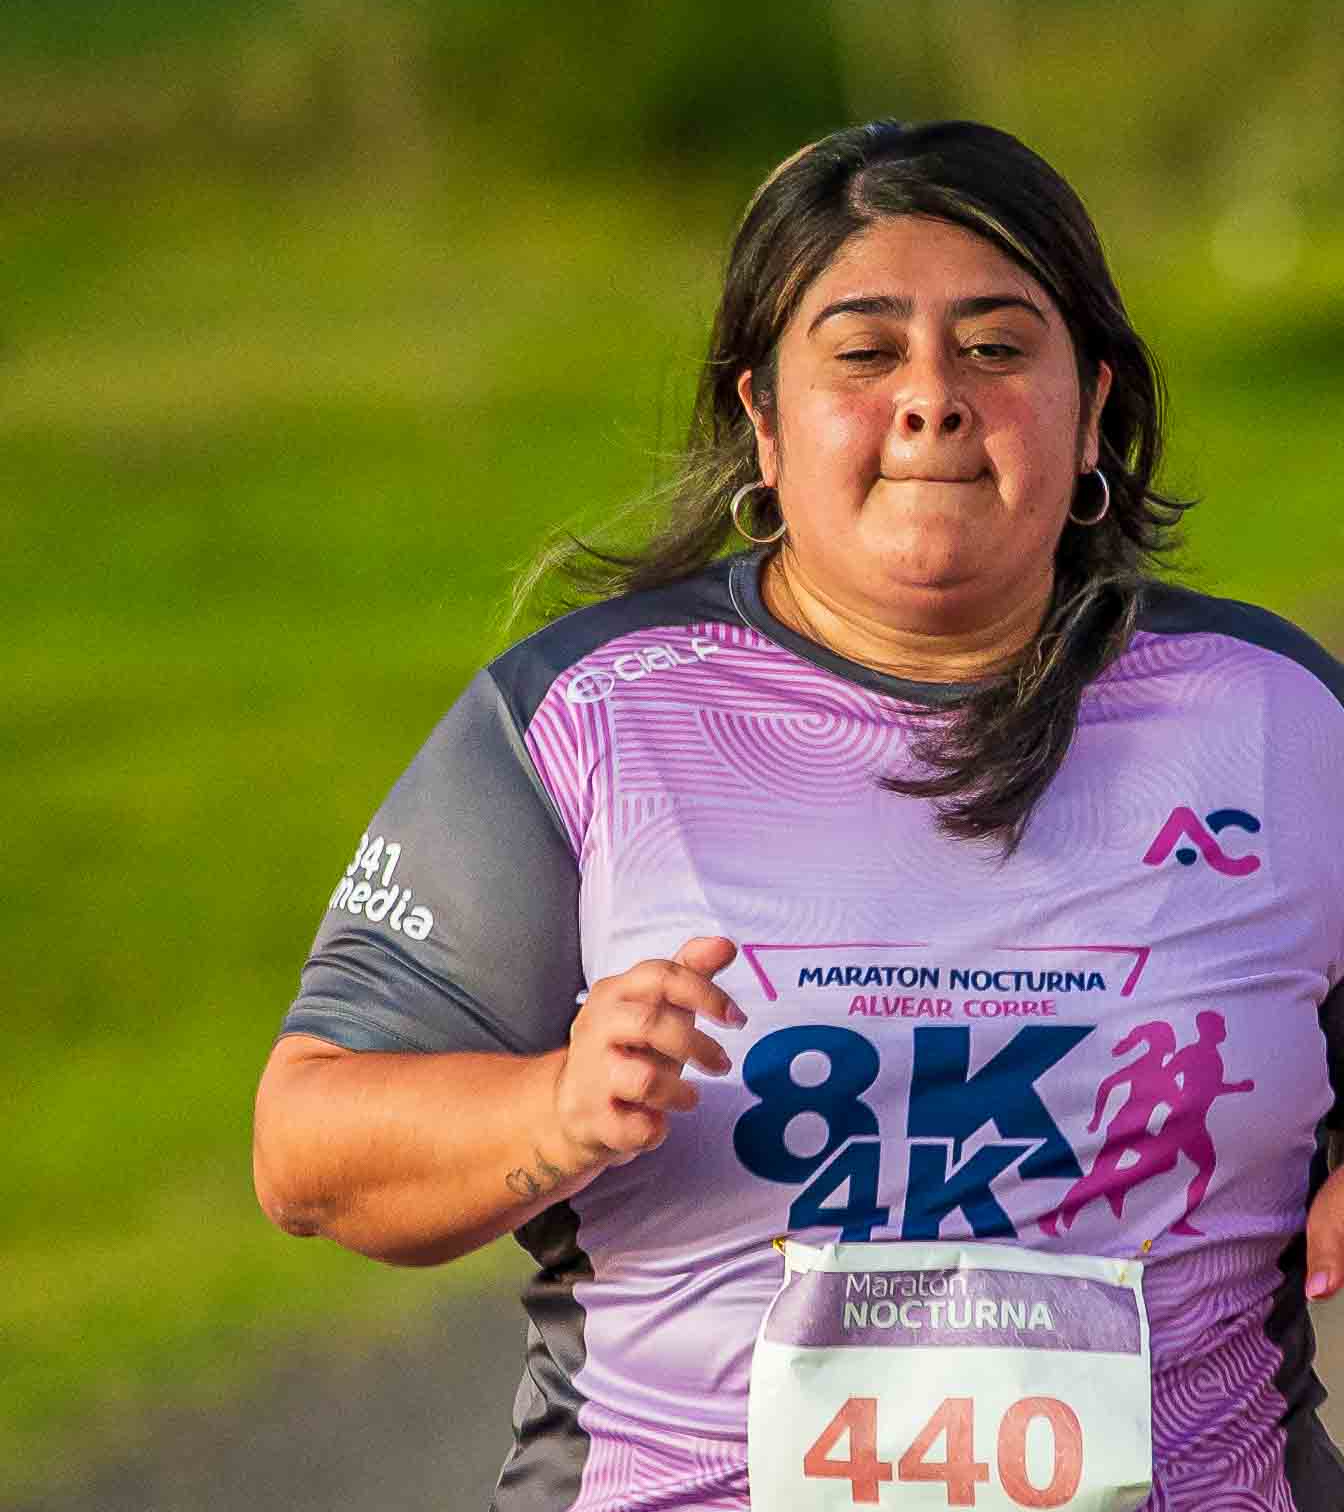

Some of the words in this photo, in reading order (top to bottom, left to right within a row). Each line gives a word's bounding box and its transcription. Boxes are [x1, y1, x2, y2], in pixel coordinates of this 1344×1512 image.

[798, 966, 942, 988] MARATON
[949, 969, 1107, 992] NOCTURNA
[848, 995, 953, 1018] ALVEAR
[963, 997, 1057, 1018] CORRE
[733, 1024, 1098, 1184] 8K
[788, 1143, 1031, 1242] 4K
[844, 1272, 968, 1298] Maratón
[842, 1300, 1056, 1331] NOCTURNA
[803, 1396, 1084, 1510] 440
